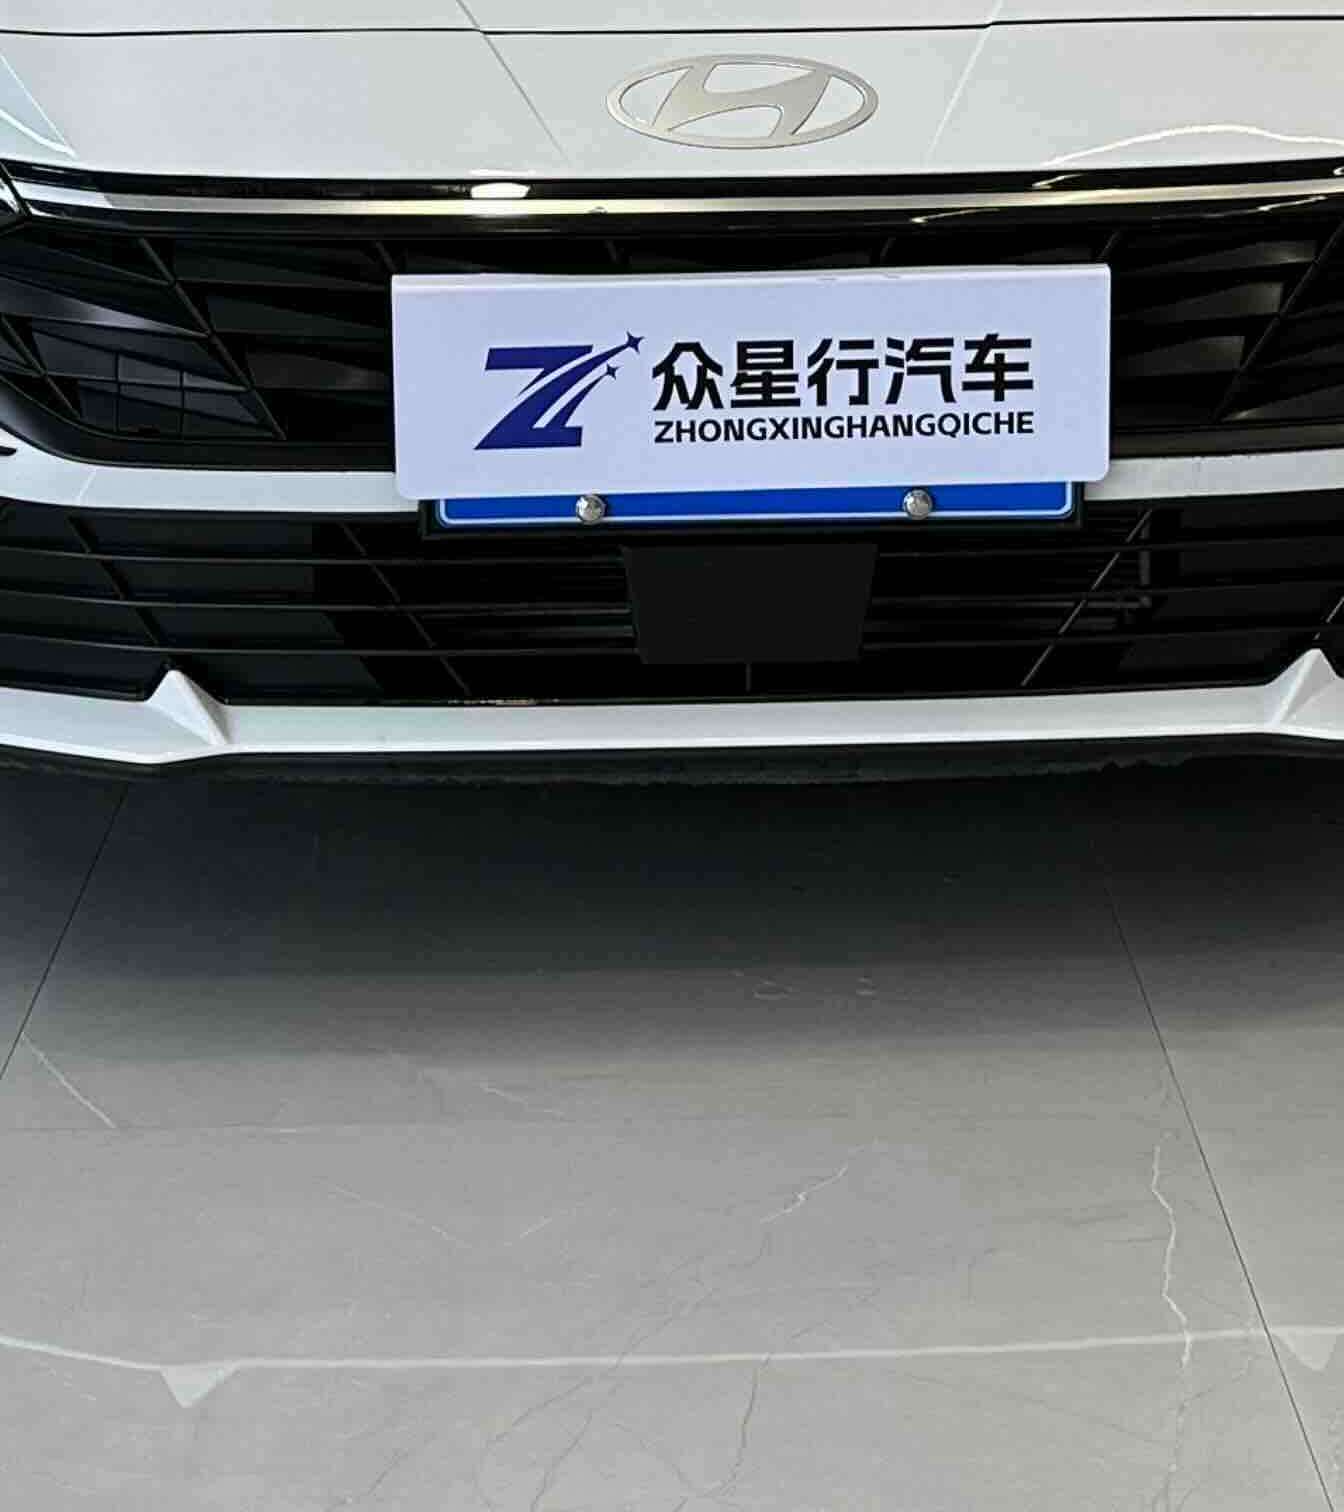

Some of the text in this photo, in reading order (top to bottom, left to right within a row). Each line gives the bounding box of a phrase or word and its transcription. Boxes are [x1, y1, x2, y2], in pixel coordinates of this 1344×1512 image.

[651, 333, 1035, 412] 众星行汽车
[653, 409, 1035, 445] ZHONGXINGHANGQICHE
